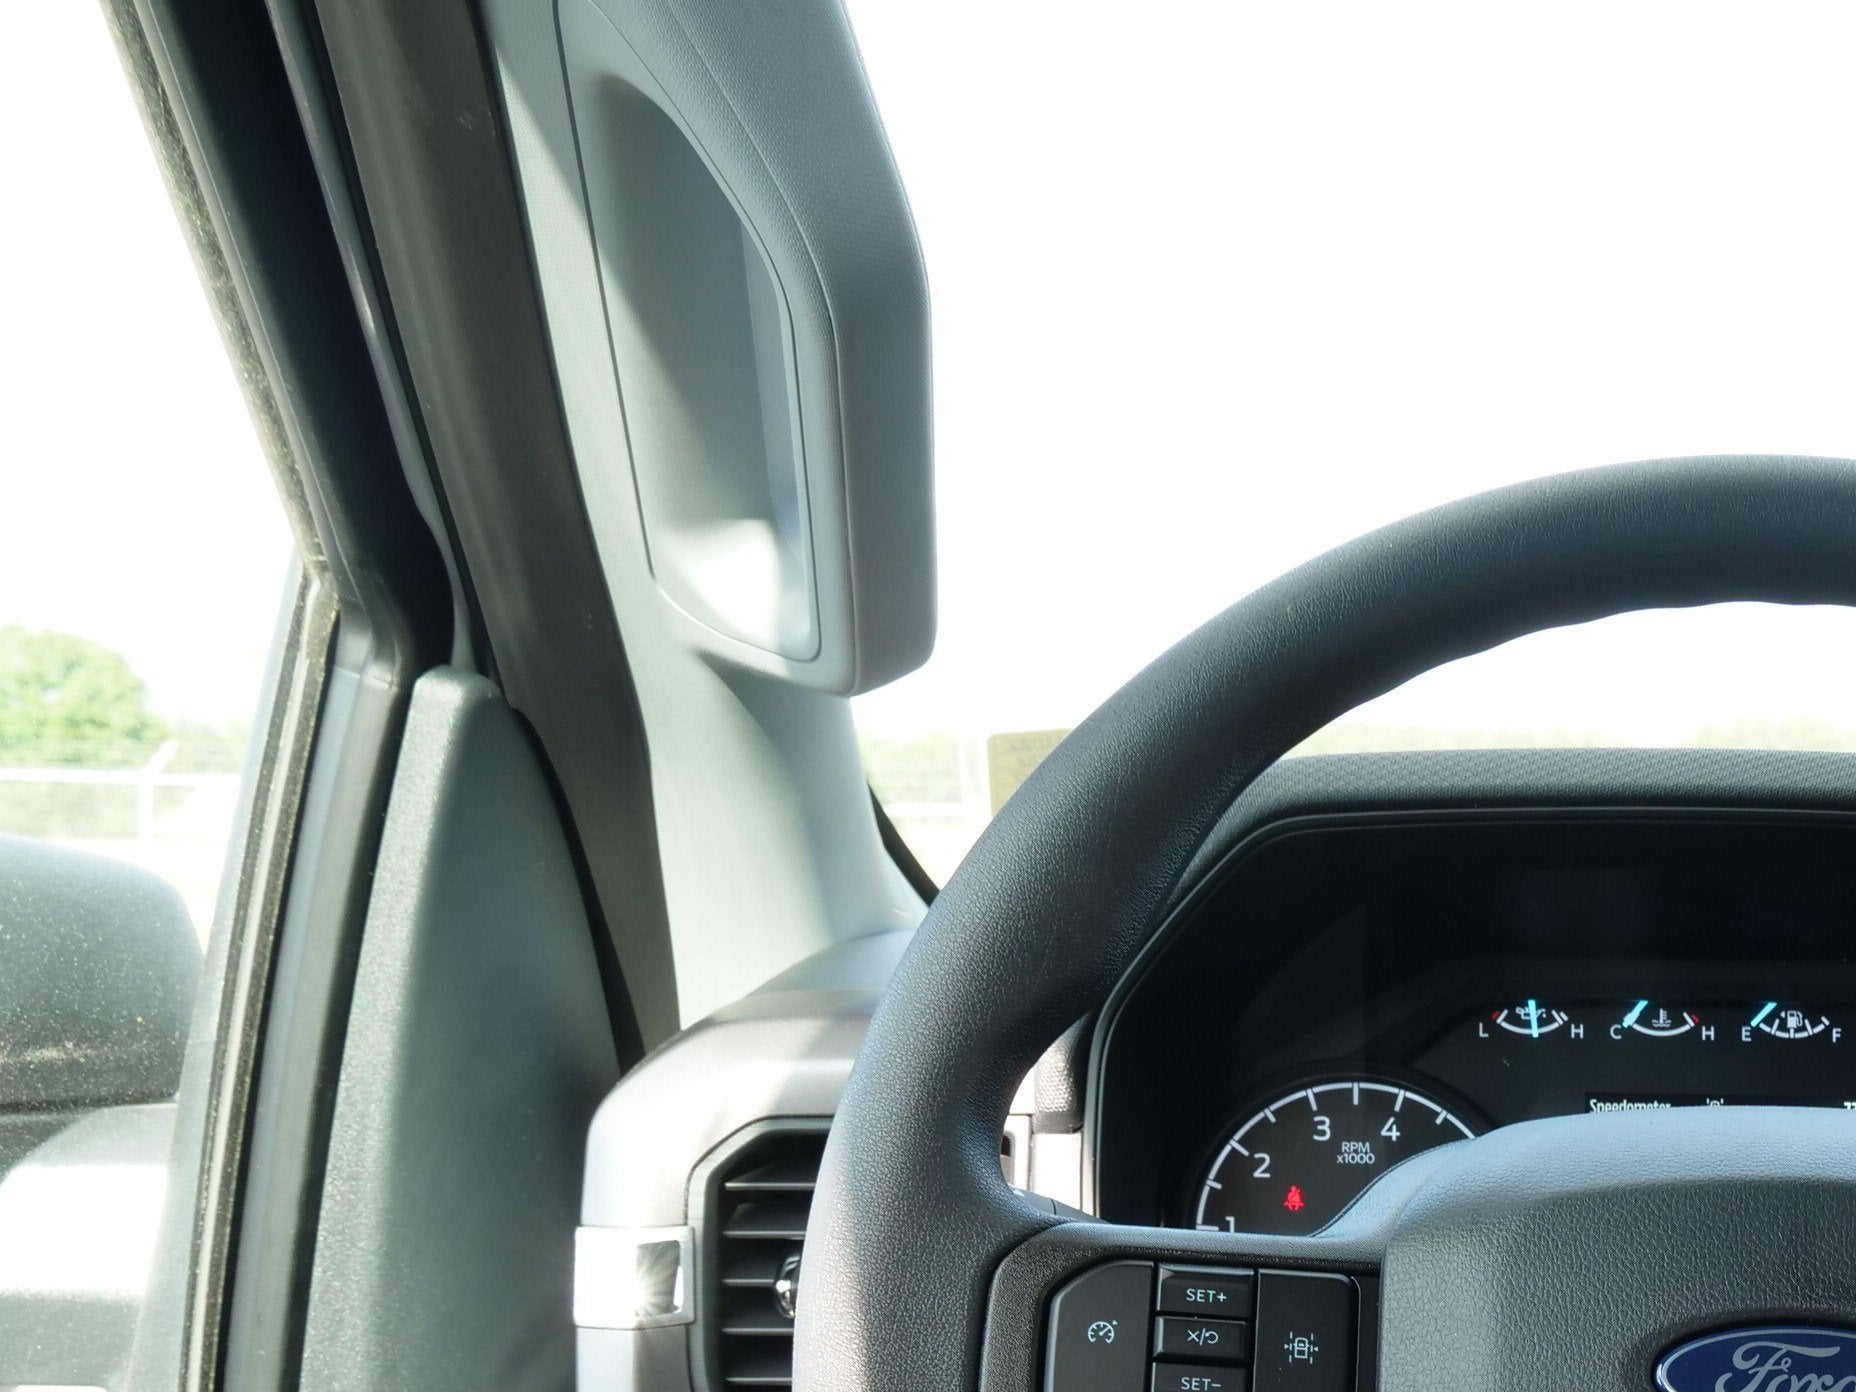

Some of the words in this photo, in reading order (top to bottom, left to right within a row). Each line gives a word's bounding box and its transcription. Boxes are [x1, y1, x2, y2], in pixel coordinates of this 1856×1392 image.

[1478, 1023, 1489, 1038] L
[1570, 1024, 1584, 1039] H
[1610, 1025, 1622, 1040] C
[1702, 1026, 1715, 1041] H
[1741, 1027, 1752, 1042] E
[1832, 1028, 1842, 1043] F
[1312, 1116, 1331, 1141] 3
[1381, 1117, 1400, 1142] 4
[1341, 1141, 1371, 1153] RPM
[1252, 1153, 1271, 1178] 2
[1336, 1153, 1375, 1165] x1000
[1186, 1288, 1227, 1303] SET+
